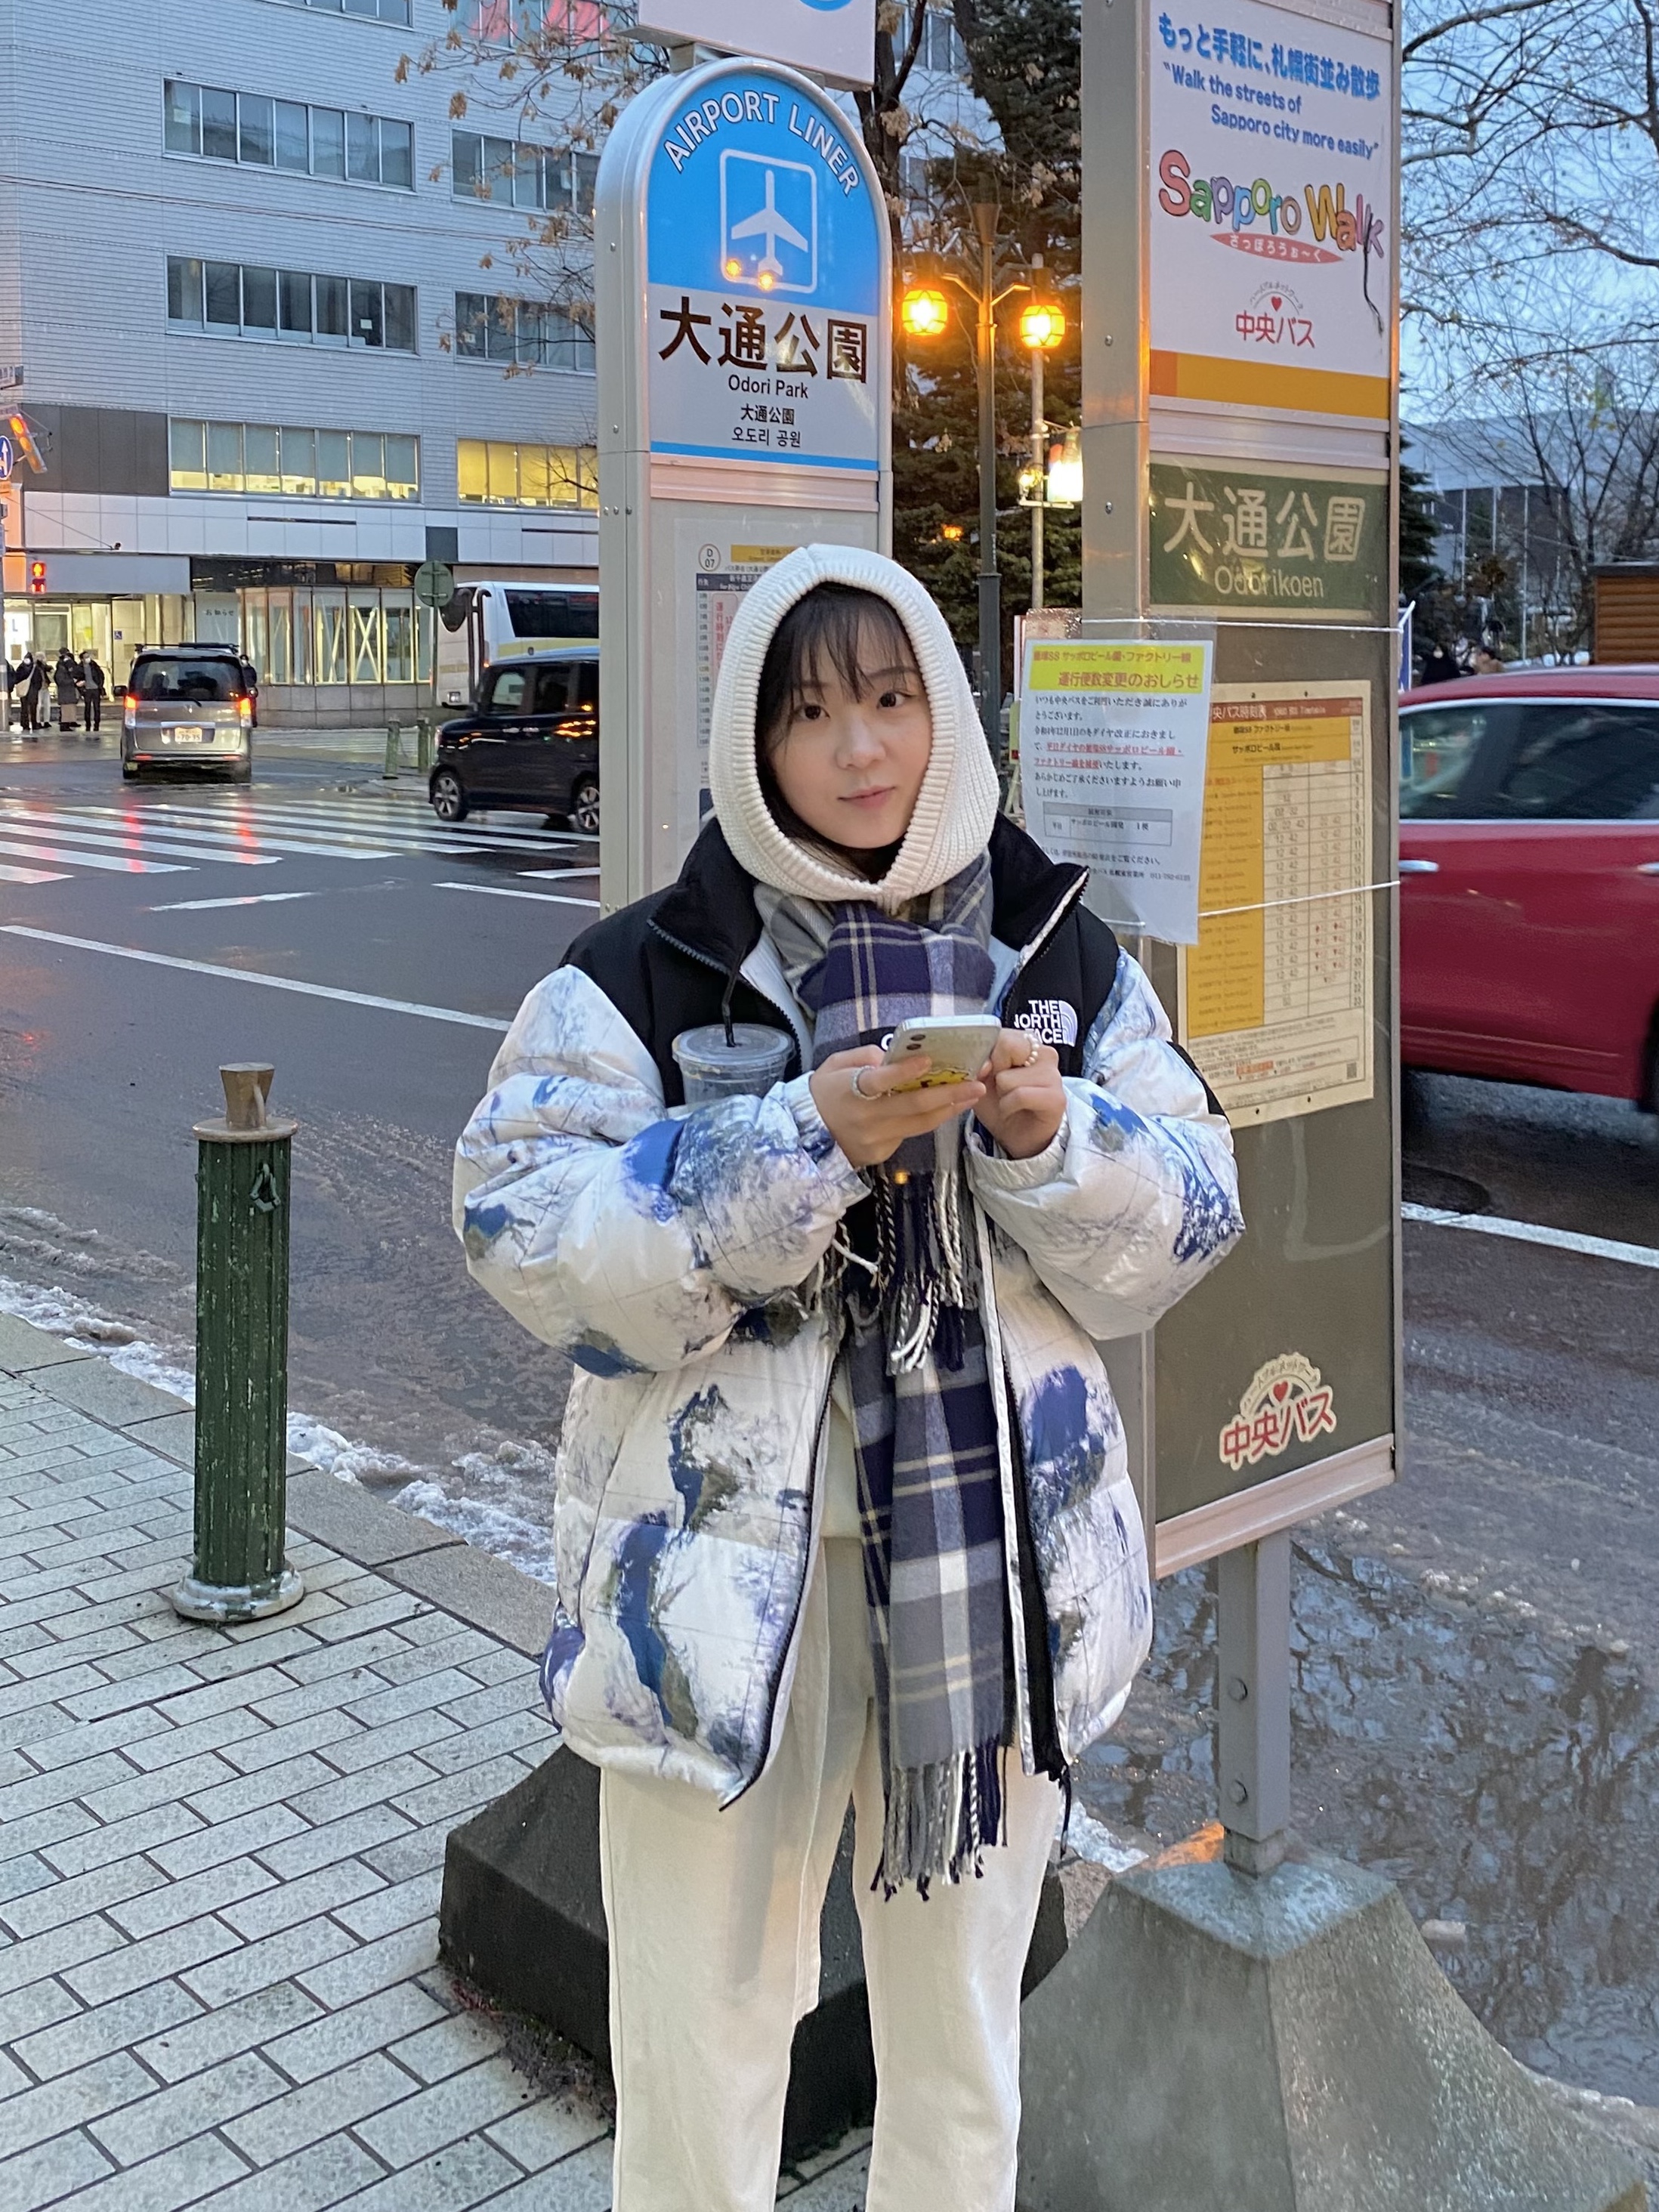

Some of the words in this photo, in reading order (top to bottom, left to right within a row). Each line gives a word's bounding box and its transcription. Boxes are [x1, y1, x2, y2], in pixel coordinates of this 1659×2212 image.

[1209, 75, 1233, 98] the
[1235, 84, 1285, 111] streets
[1287, 95, 1302, 114] of
[663, 90, 780, 173] AIRPORT
[788, 102, 860, 196] LINER
[1211, 103, 1271, 135] Sapporo
[1274, 121, 1299, 143] city
[1302, 130, 1335, 151] more
[1159, 150, 1302, 235] Sapporo
[1305, 183, 1384, 258] Walk
[659, 296, 867, 384] 大通公園
[1236, 310, 1316, 348] 中央バス
[728, 374, 771, 395] Odori
[776, 379, 808, 399] Park
[740, 403, 795, 425] 大通公園
[731, 427, 769, 446] 오도리
[777, 430, 801, 447] 공원
[1163, 481, 1365, 561] 大通公園
[705, 559, 715, 567] 07
[707, 548, 713, 558] D
[1214, 566, 1324, 598] Odorikoen
[1213, 704, 1267, 720] 央バス時刻表
[1028, 999, 1059, 1014] THE
[1025, 1028, 1063, 1044] ACE
[1224, 1391, 1333, 1463] 中央バス
